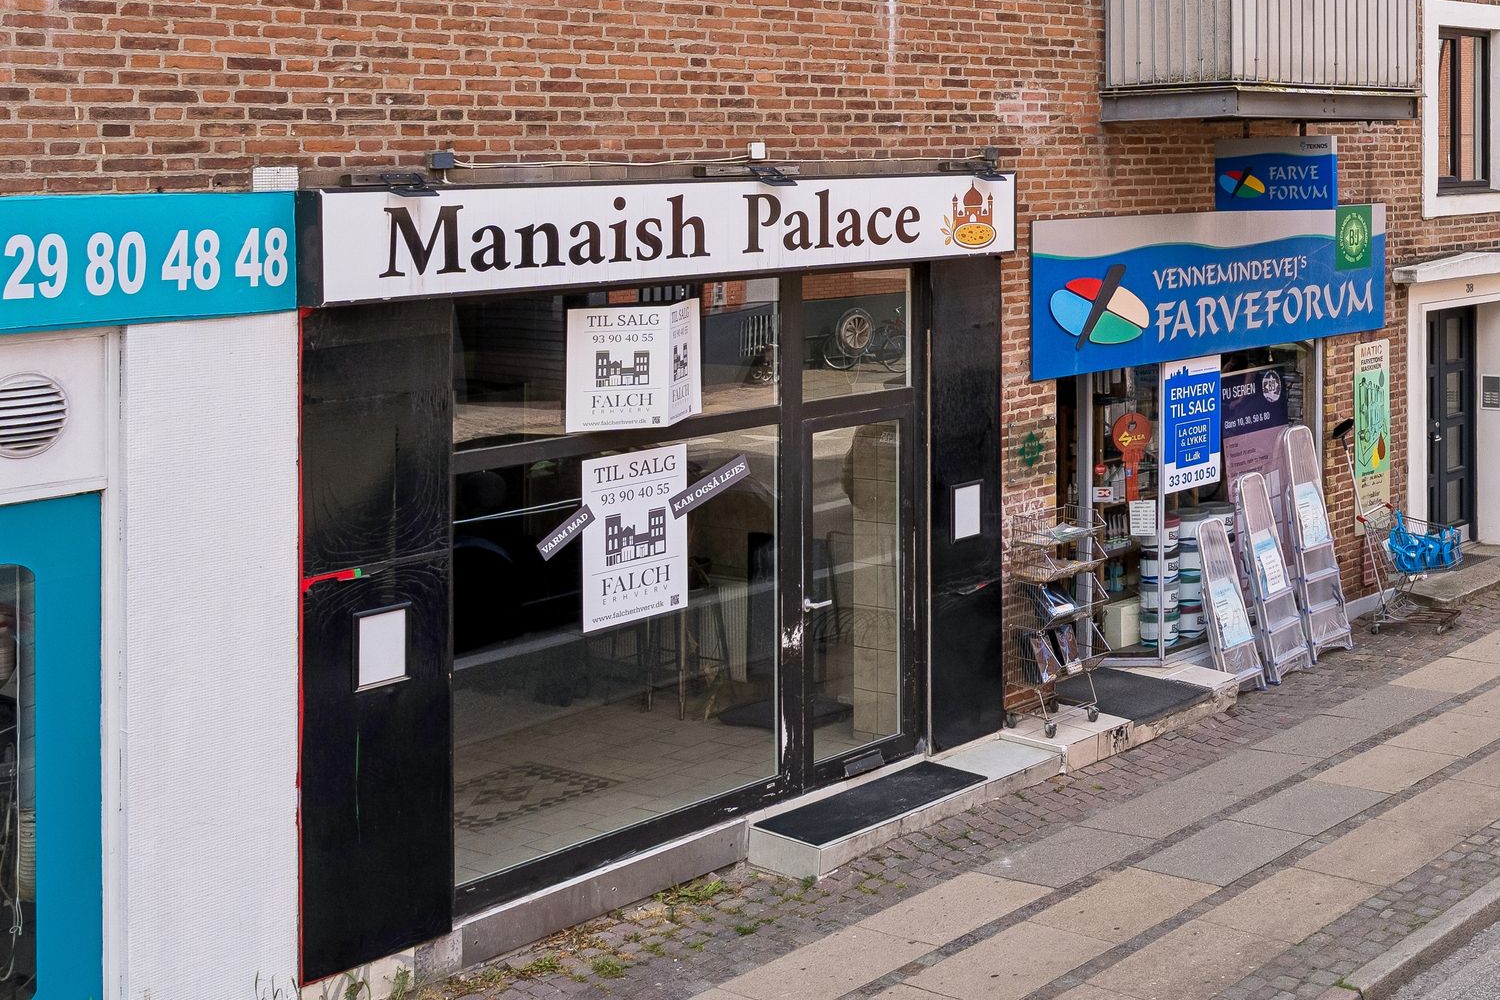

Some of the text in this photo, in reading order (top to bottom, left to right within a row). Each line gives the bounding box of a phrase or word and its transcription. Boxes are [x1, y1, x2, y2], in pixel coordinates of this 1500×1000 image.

[1269, 165, 1319, 180] FARVE
[1269, 185, 1328, 200] FORUM
[378, 189, 921, 279] Manaish Palace
[1350, 229, 1360, 246] BJ
[2, 227, 288, 300] 29 80 48 48
[1466, 283, 1474, 293] 38
[587, 313, 660, 327] TIL SALG
[1154, 278, 1374, 343] FARVEFORUM
[592, 333, 654, 343] 93 90 40 55
[1361, 344, 1383, 358] MATIC
[592, 393, 653, 408] FALCH
[1170, 381, 1215, 401] ERHVERV
[1232, 383, 1256, 398] SERIEN
[1170, 398, 1216, 419] TIL SALG
[1178, 424, 1207, 437] LA COUR
[1180, 435, 1207, 447] & LYKKE
[594, 455, 676, 484] TIL SALG
[1169, 466, 1216, 487] 33 30 10 50
[601, 482, 670, 505] 93 90 40 55
[674, 462, 746, 512] KAN OGSÅ LEJES
[541, 513, 588, 555] VARM MAD
[601, 565, 670, 596] FALCH
[603, 585, 668, 605] ERHVERV
[592, 601, 665, 624] www.falcherhverv.dk
